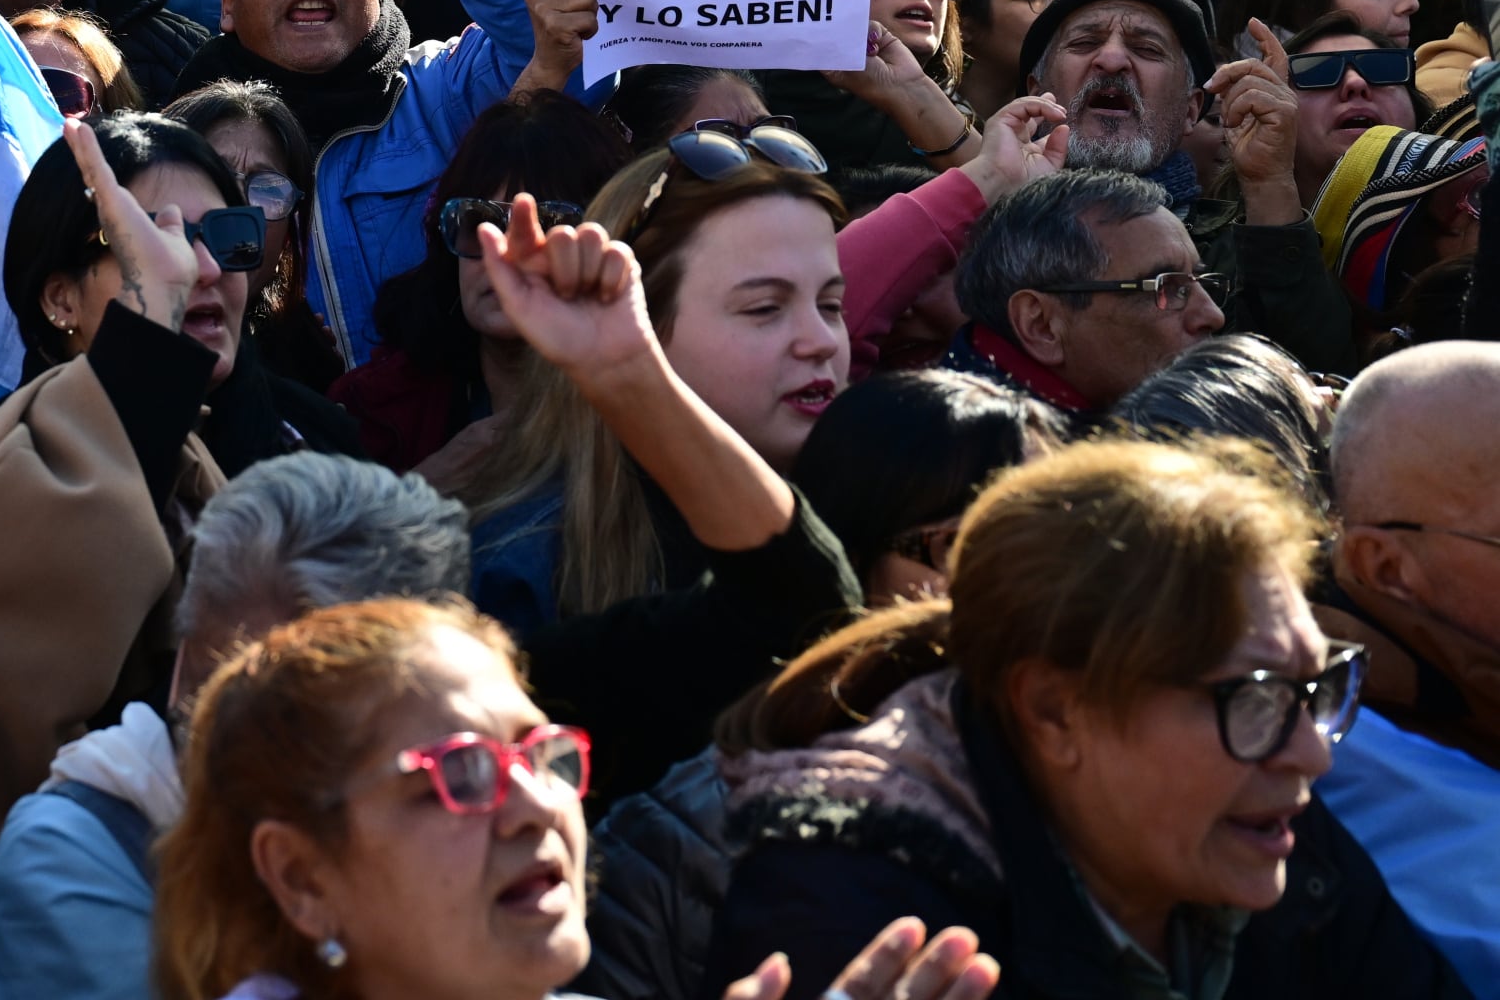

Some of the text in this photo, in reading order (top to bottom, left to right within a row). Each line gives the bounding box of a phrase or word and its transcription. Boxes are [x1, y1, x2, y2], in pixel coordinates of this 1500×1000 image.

[597, 3, 624, 25] Y
[635, 5, 684, 29] LO
[600, 36, 629, 51] FUERZA
[638, 36, 663, 44] AMOR
[665, 39, 688, 47] PARA
